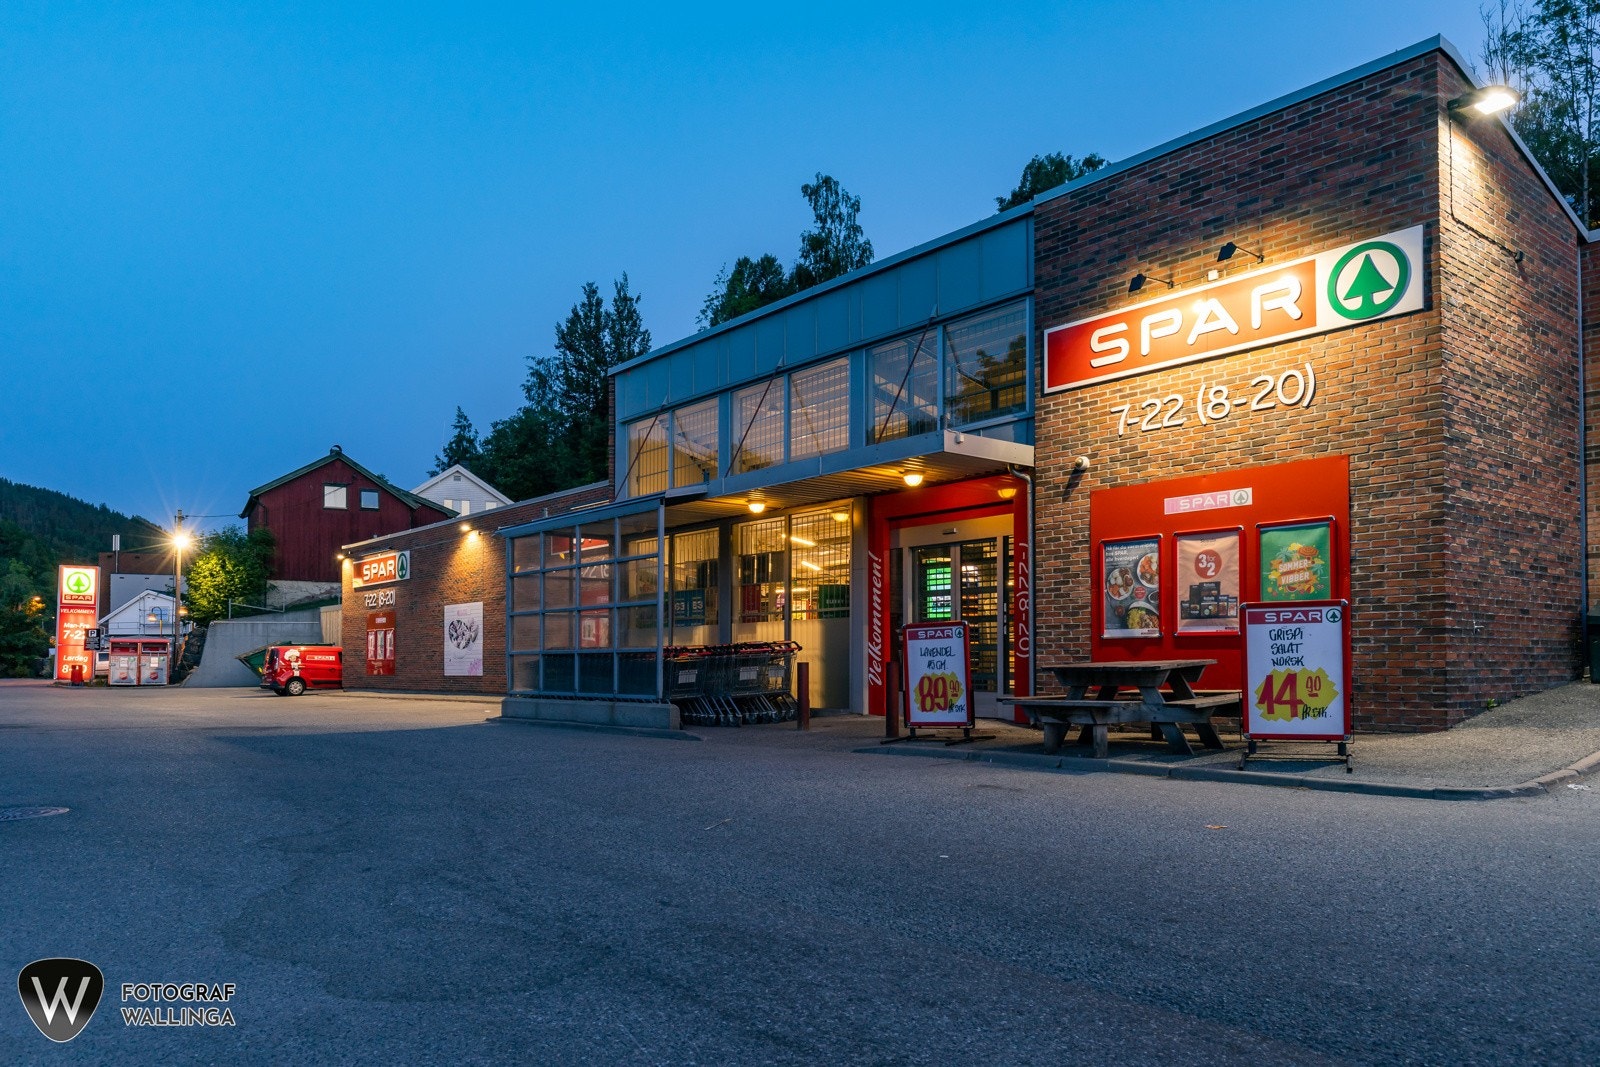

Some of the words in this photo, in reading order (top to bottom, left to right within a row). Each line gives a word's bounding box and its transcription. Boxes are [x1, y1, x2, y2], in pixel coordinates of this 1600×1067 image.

[1088, 275, 1303, 368] SPAR
[1111, 393, 1187, 437] 7-22
[1196, 362, 1316, 425] (8-20)
[1179, 492, 1229, 511] SPAR
[1198, 554, 1207, 568] 3
[363, 559, 395, 581] SPAR
[1207, 562, 1215, 576] 2
[1281, 571, 1310, 585] VIBBER
[868, 549, 882, 686] Velkommen!
[1264, 611, 1322, 623] SPAR
[918, 629, 953, 639] SPAR
[920, 646, 956, 657] LAVENDEL
[1271, 642, 1303, 655] SALAT
[1271, 655, 1305, 667] NORSK
[919, 675, 949, 713] 89
[1258, 673, 1305, 718] 14
